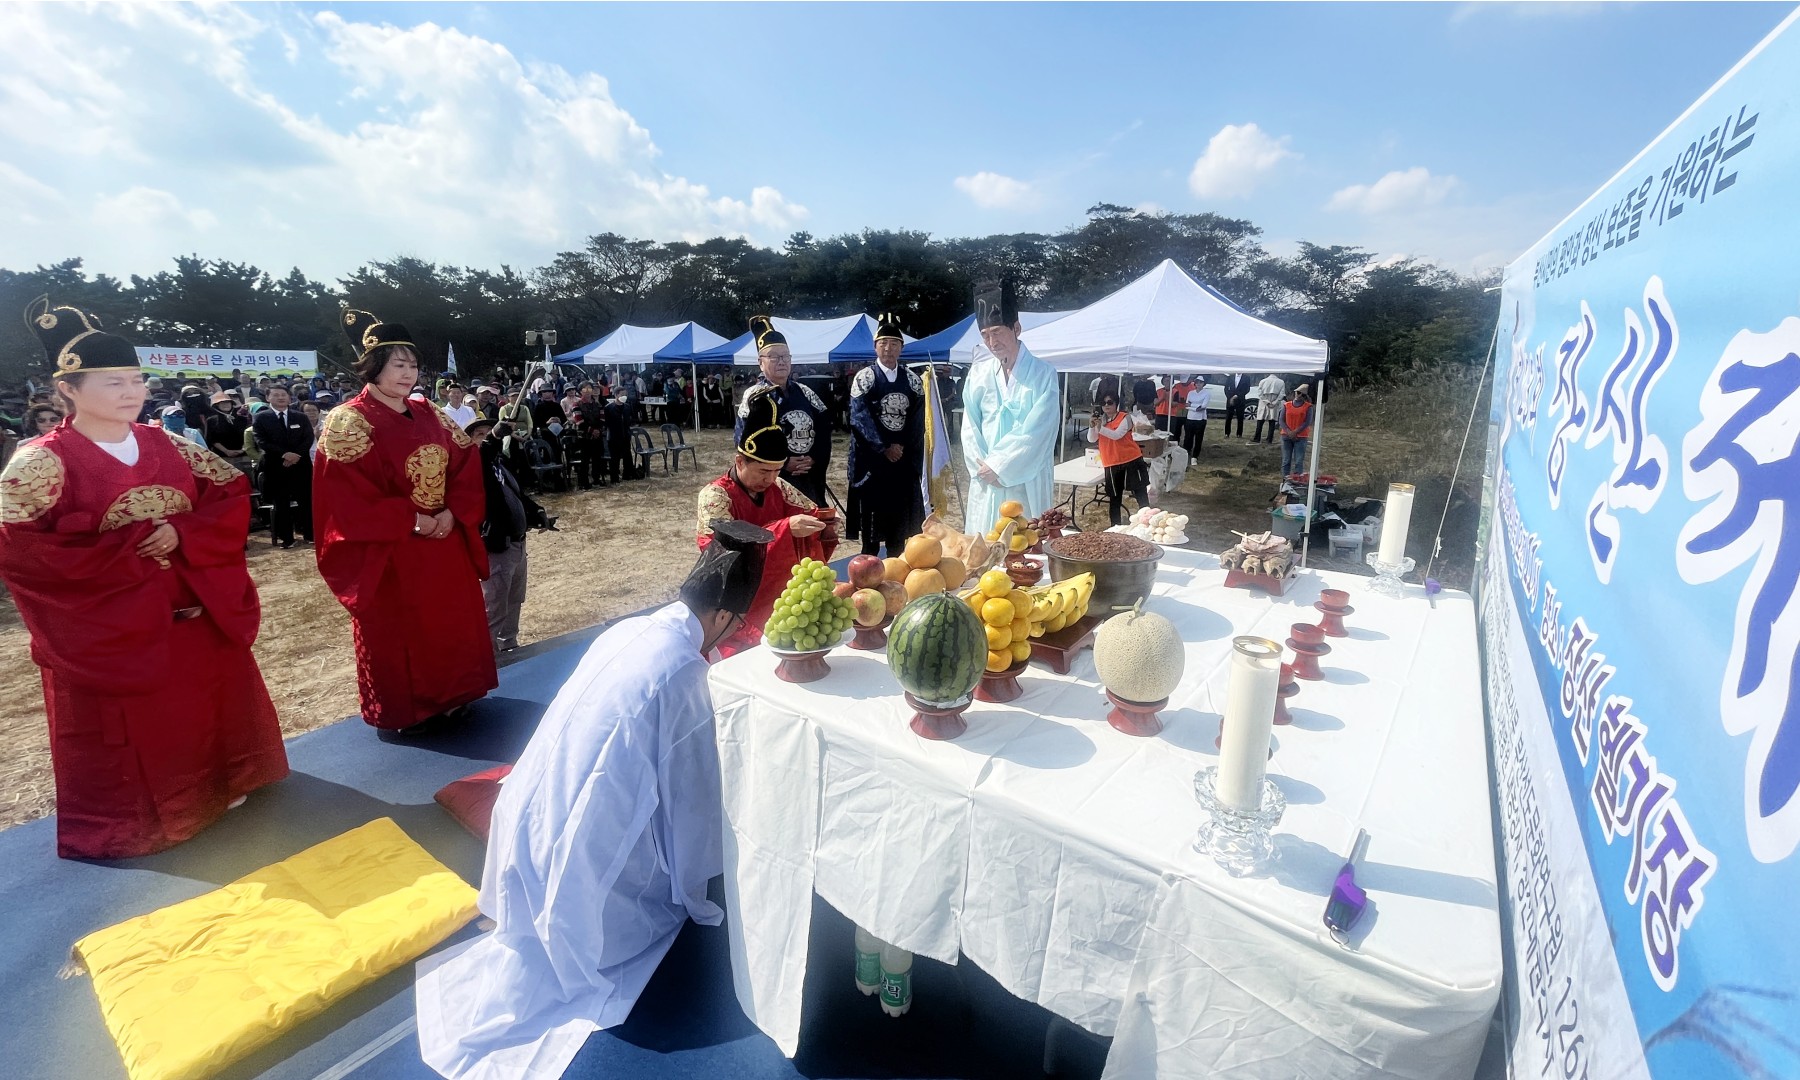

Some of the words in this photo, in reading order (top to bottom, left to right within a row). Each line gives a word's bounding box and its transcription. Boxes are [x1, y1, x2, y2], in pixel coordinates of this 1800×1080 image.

[1582, 208, 1607, 266] 장산
[1603, 174, 1653, 251] 보존을
[1649, 103, 1760, 227] 기원하는
[149, 353, 224, 366] 산불조심은
[230, 355, 270, 367] 산과의
[274, 355, 300, 367] 약속
[1562, 621, 1610, 757] 장산
[1595, 700, 1711, 980] 헬기장
